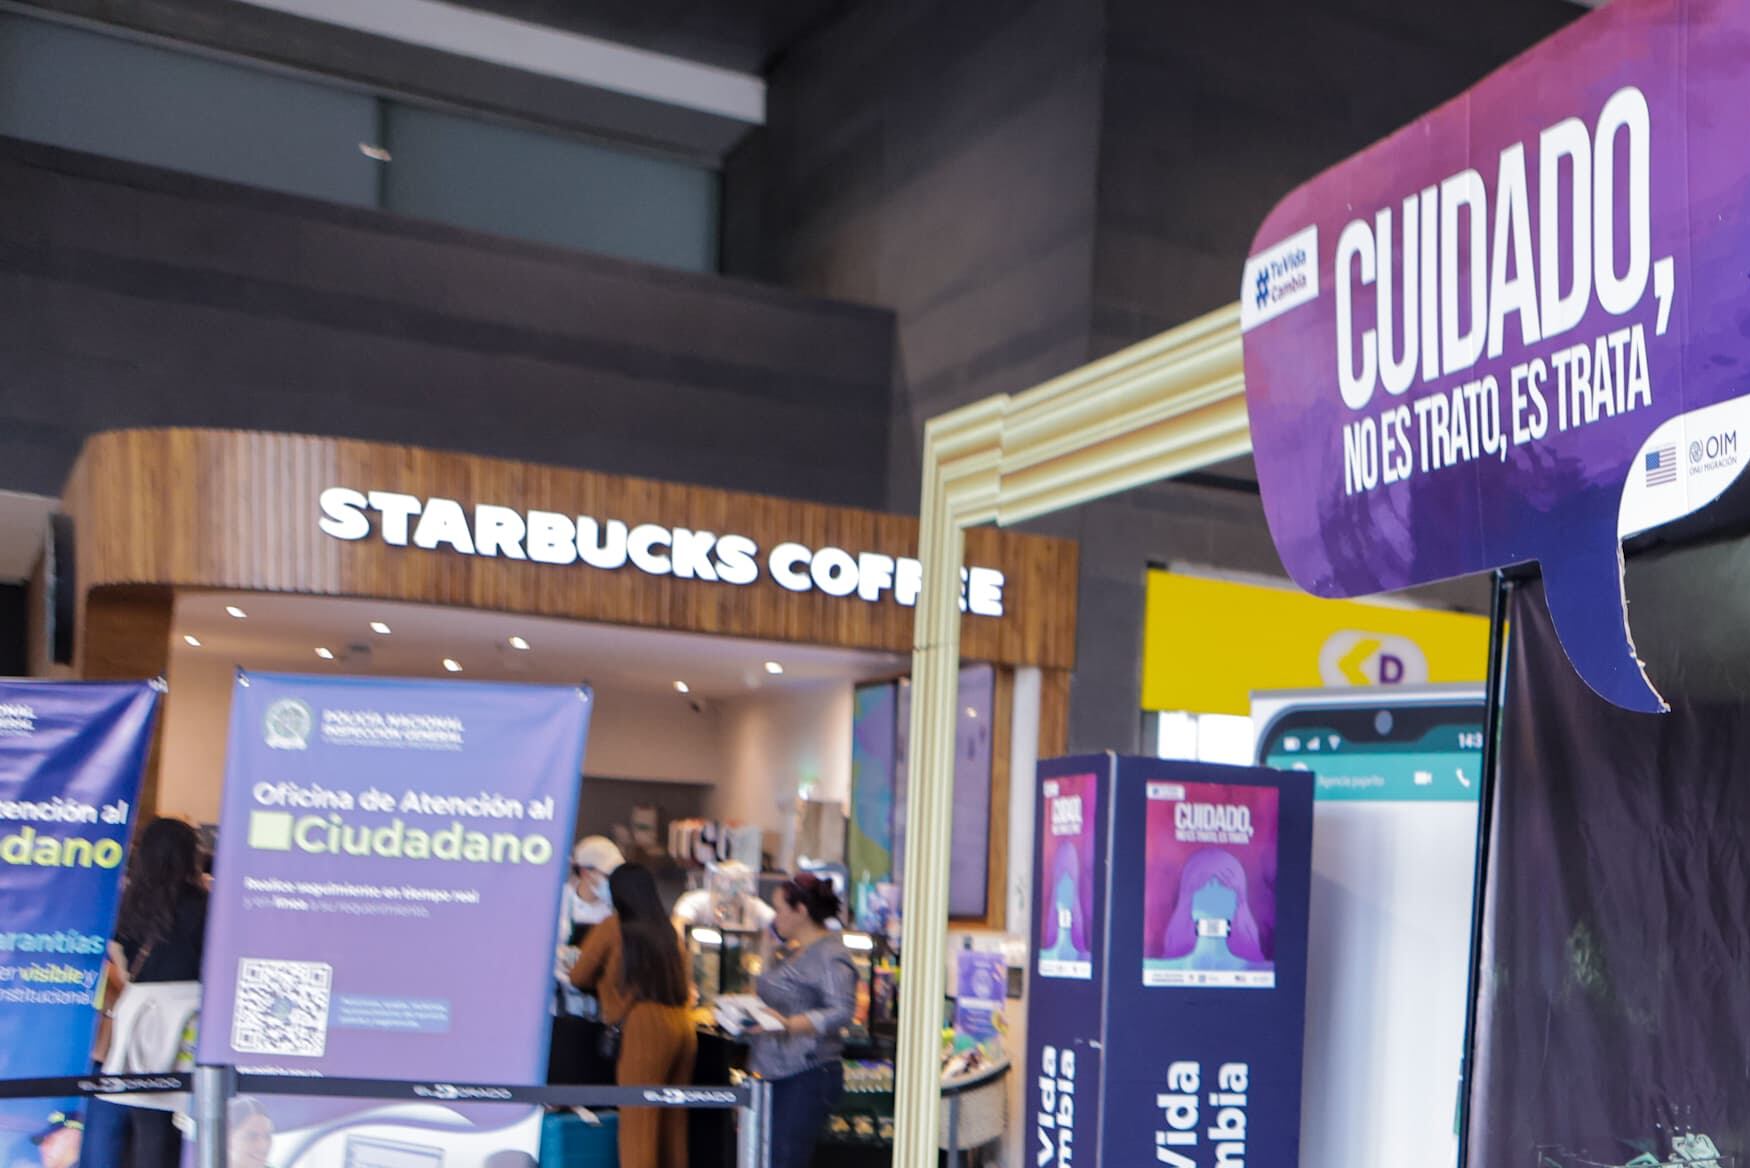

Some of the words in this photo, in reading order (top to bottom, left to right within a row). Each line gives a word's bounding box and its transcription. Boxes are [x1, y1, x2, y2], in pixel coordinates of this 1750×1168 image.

[1334, 86, 1674, 409] CUIDADO,
[1271, 273, 1307, 303] Cambia
[1343, 416, 1378, 496] NO
[1381, 405, 1413, 484] ES
[1414, 375, 1507, 463] TRATO,
[1511, 359, 1548, 445] ES
[1552, 323, 1652, 431] TRATA
[1706, 429, 1737, 459] OIM
[318, 487, 758, 585] STARBUCKS
[769, 542, 1004, 617] COFFE
[1379, 654, 1405, 684] D
[100, 799, 129, 825] al
[253, 781, 354, 811] Oficina
[359, 786, 397, 813] de
[400, 789, 524, 820] Atención
[527, 795, 554, 821] al
[1175, 802, 1253, 838] CUIDADO,
[294, 812, 553, 865] Ciudadano
